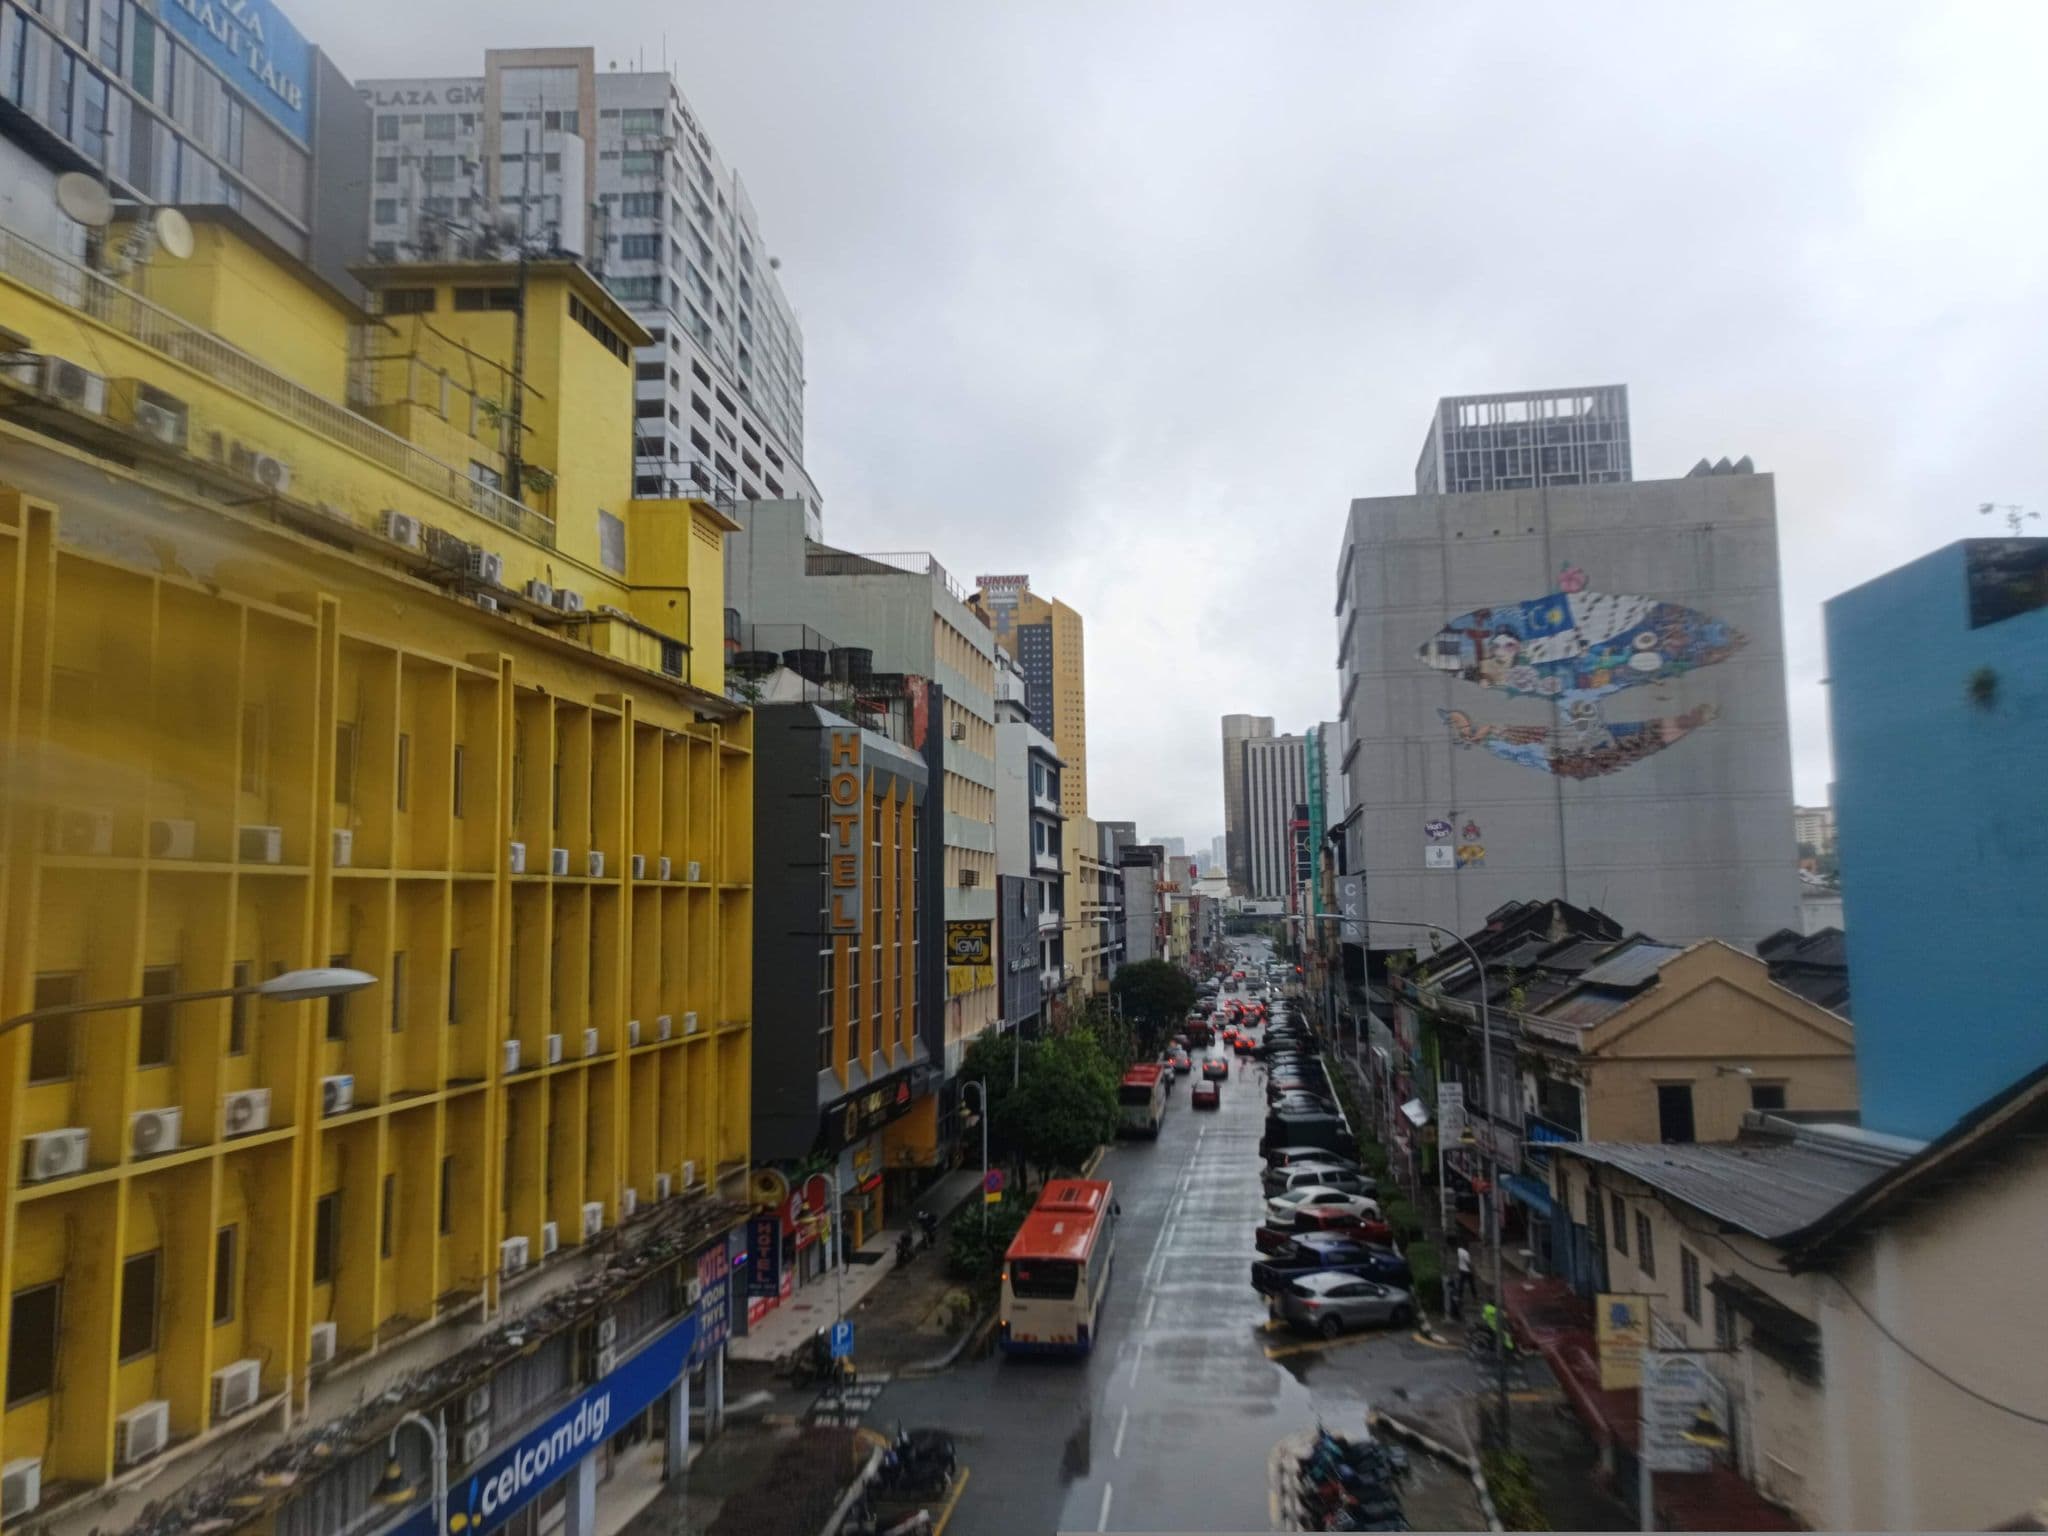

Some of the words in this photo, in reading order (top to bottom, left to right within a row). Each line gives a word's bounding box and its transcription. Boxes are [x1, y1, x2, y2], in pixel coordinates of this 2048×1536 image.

[246, 40, 302, 113] TAIB
[357, 88, 438, 106] PLAZA
[975, 576, 1029, 587] SUNWAY
[831, 733, 860, 929] HOTEL
[957, 940, 981, 953] GM
[836, 1324, 849, 1345] P
[481, 1391, 612, 1516] celcomdigi
